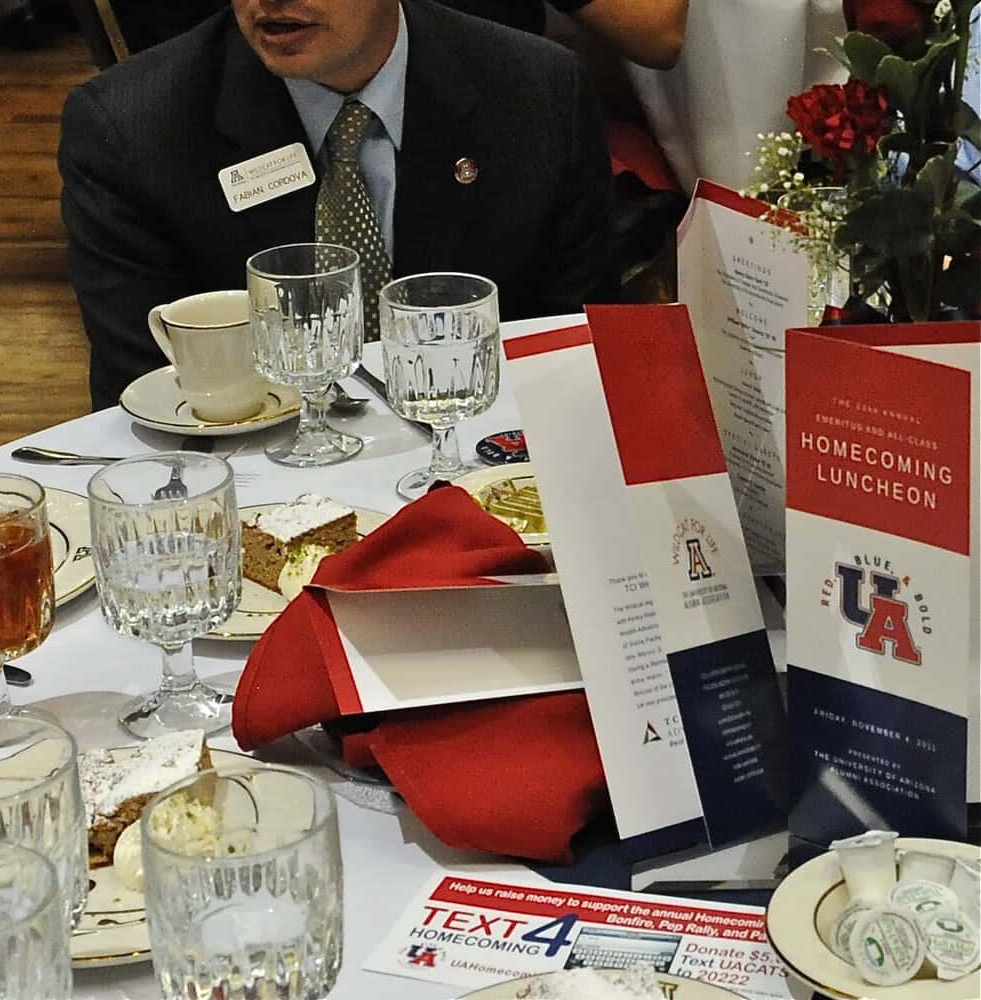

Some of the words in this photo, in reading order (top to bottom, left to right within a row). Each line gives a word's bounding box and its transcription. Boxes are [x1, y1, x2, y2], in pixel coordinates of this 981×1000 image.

[233, 186, 264, 203] FABIAN
[267, 170, 308, 190] CORDOVA
[816, 413, 863, 432] EMERITUS
[866, 425, 885, 437] AND
[801, 431, 953, 485] HOMECOMING
[817, 463, 937, 510] LUNCHEON
[685, 538, 712, 582] A
[835, 561, 923, 667] UA
[914, 592, 933, 635] BOLD
[851, 719, 901, 740] NOVEMBER
[813, 750, 829, 761] THE
[832, 756, 883, 776] UNIVERSITY
[899, 776, 937, 794] ARIZONA
[863, 776, 920, 800] ASSOCIATION
[449, 881, 476, 895] Help
[478, 886, 492, 896] us
[494, 888, 525, 901] raise
[526, 894, 565, 907] money
[567, 897, 580, 907] to
[581, 900, 628, 914] support
[630, 904, 651, 916] the
[651, 908, 693, 922] annual
[695, 912, 765, 929] Homecomi
[409, 927, 541, 956] HOMECOMING
[421, 905, 529, 939] TEXT
[521, 912, 581, 959] 4
[607, 913, 655, 930] Bonfire,
[658, 920, 684, 933] Pep
[685, 923, 720, 938] Rally,
[723, 929, 750, 940] and
[681, 954, 714, 968] Text
[719, 959, 789, 979] UACATS
[685, 943, 745, 959] Donate
[676, 967, 692, 978] to
[696, 969, 750, 986] 20222
